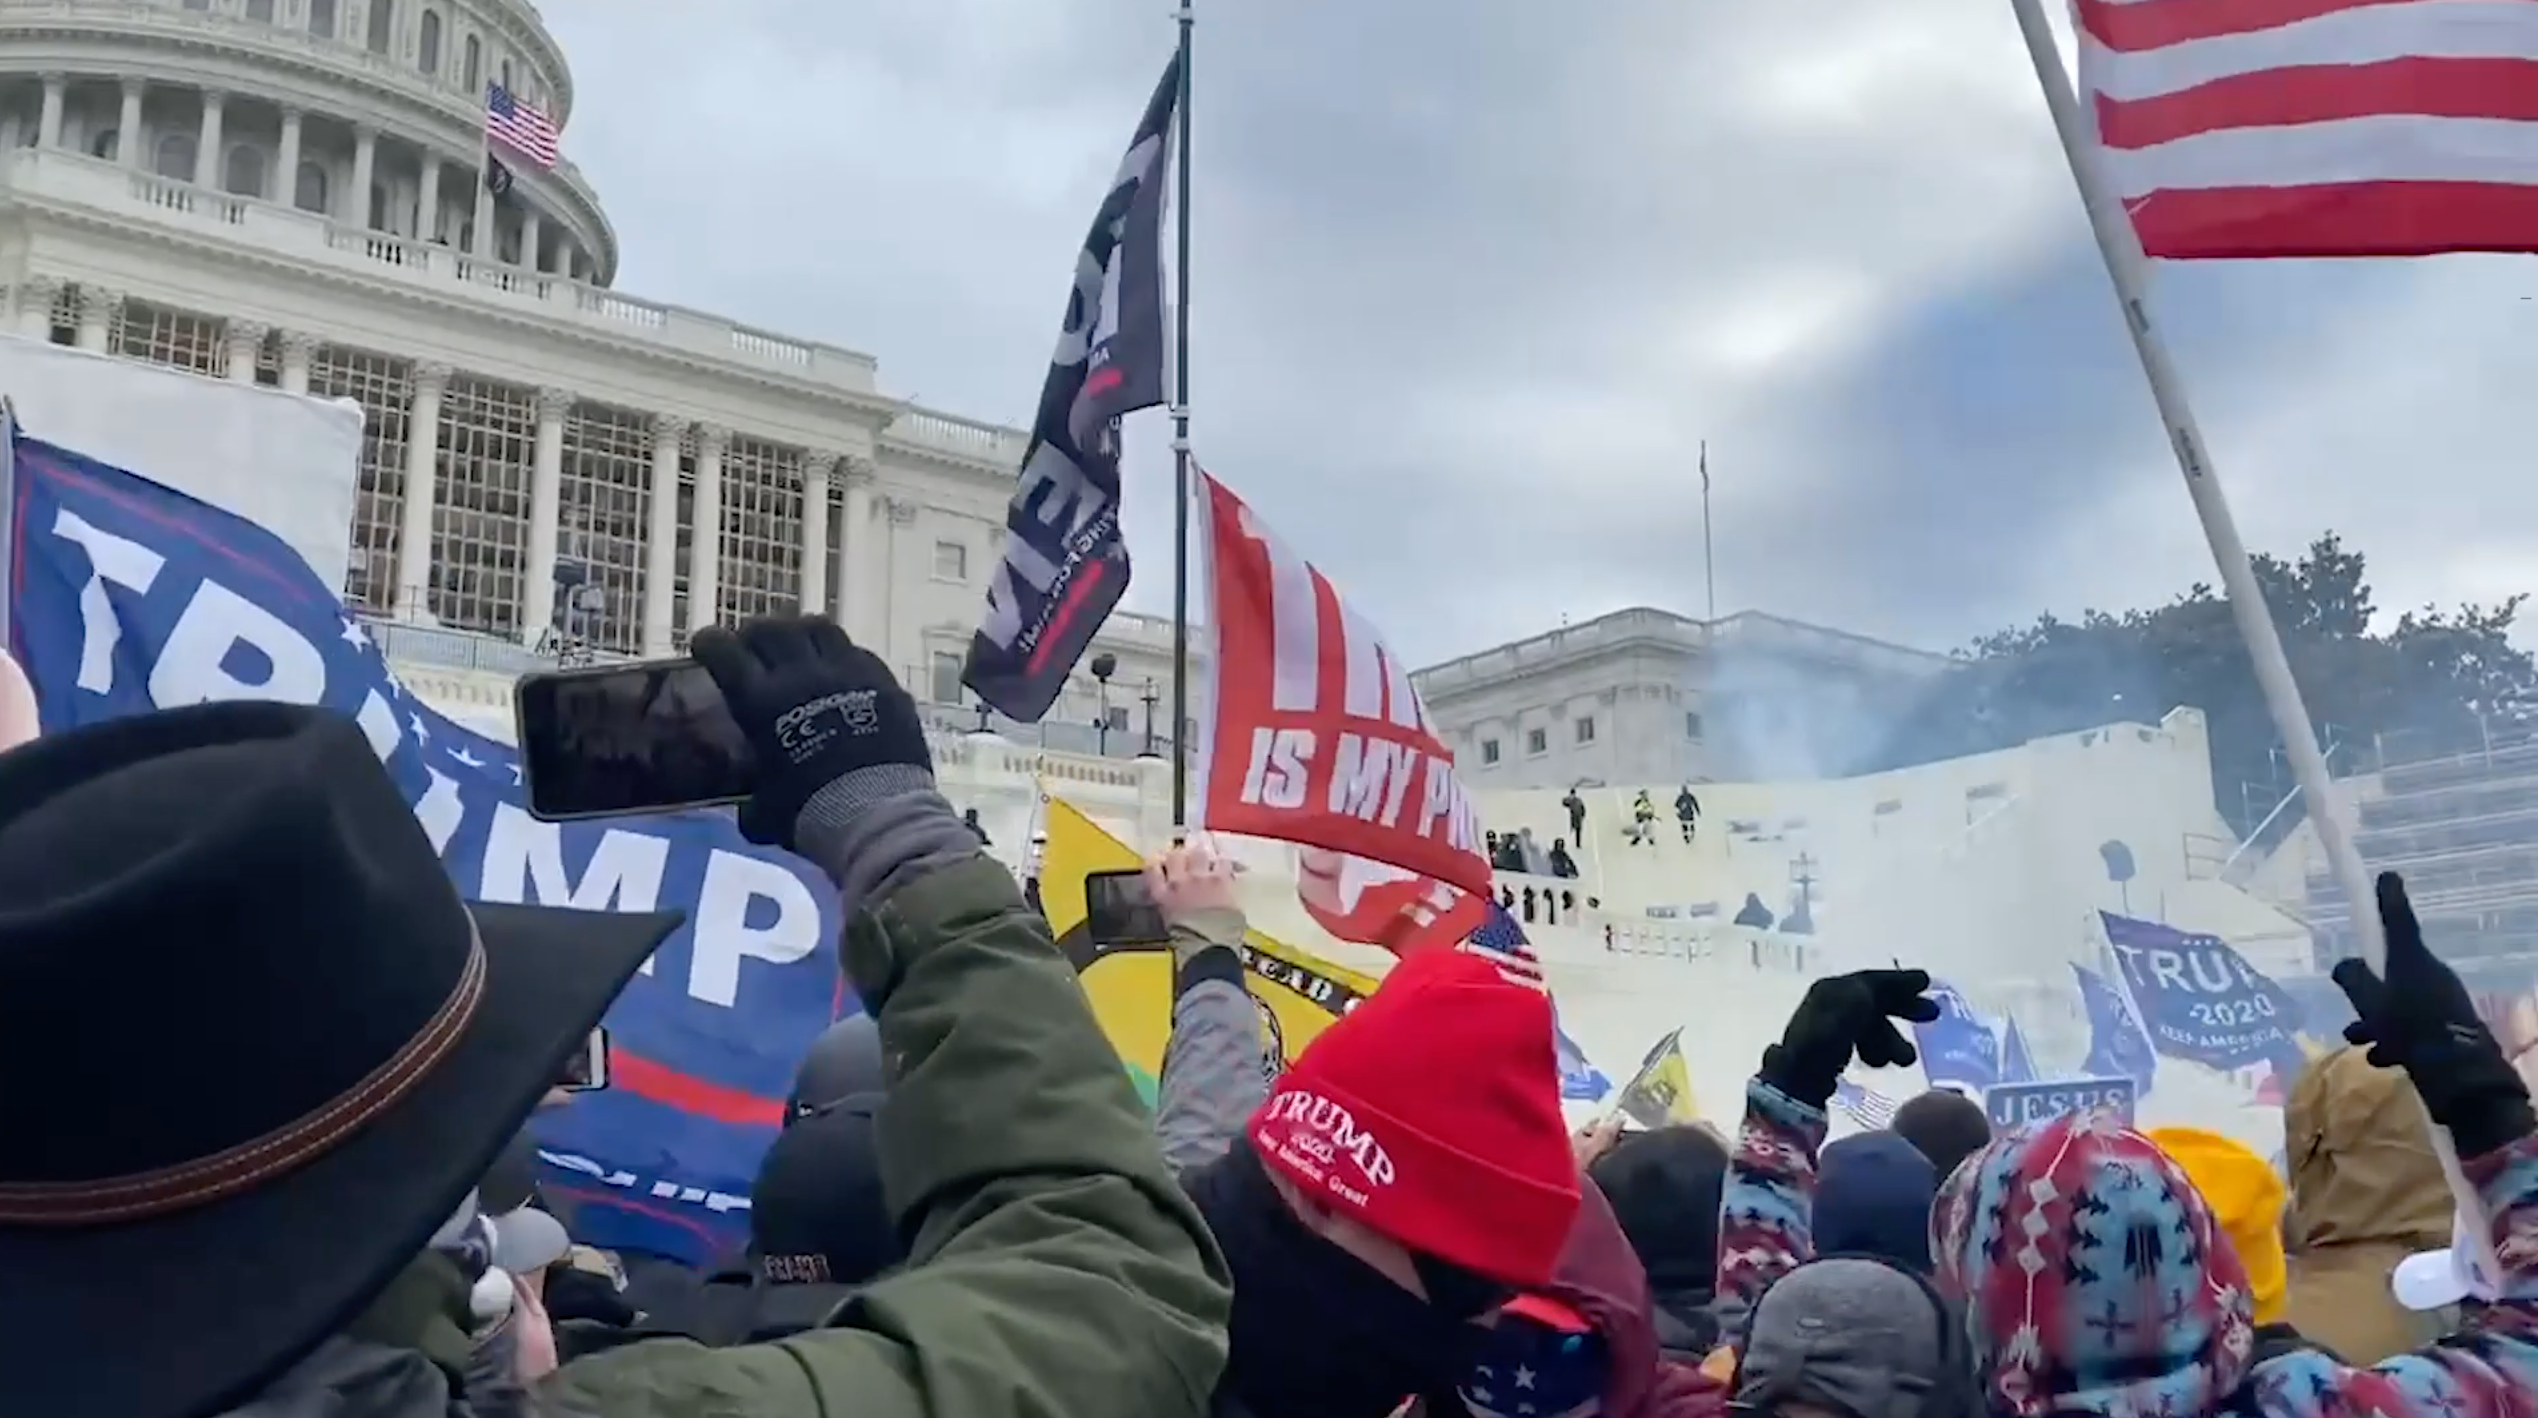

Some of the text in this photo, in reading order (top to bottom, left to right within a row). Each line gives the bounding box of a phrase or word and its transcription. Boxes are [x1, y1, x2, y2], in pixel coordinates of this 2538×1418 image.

[1240, 727, 1317, 809] IS
[1327, 732, 1422, 829] MY
[2114, 944, 2256, 993] TRU
[1265, 1090, 1397, 1187] TRUMP
[1328, 1174, 1370, 1208] Great
